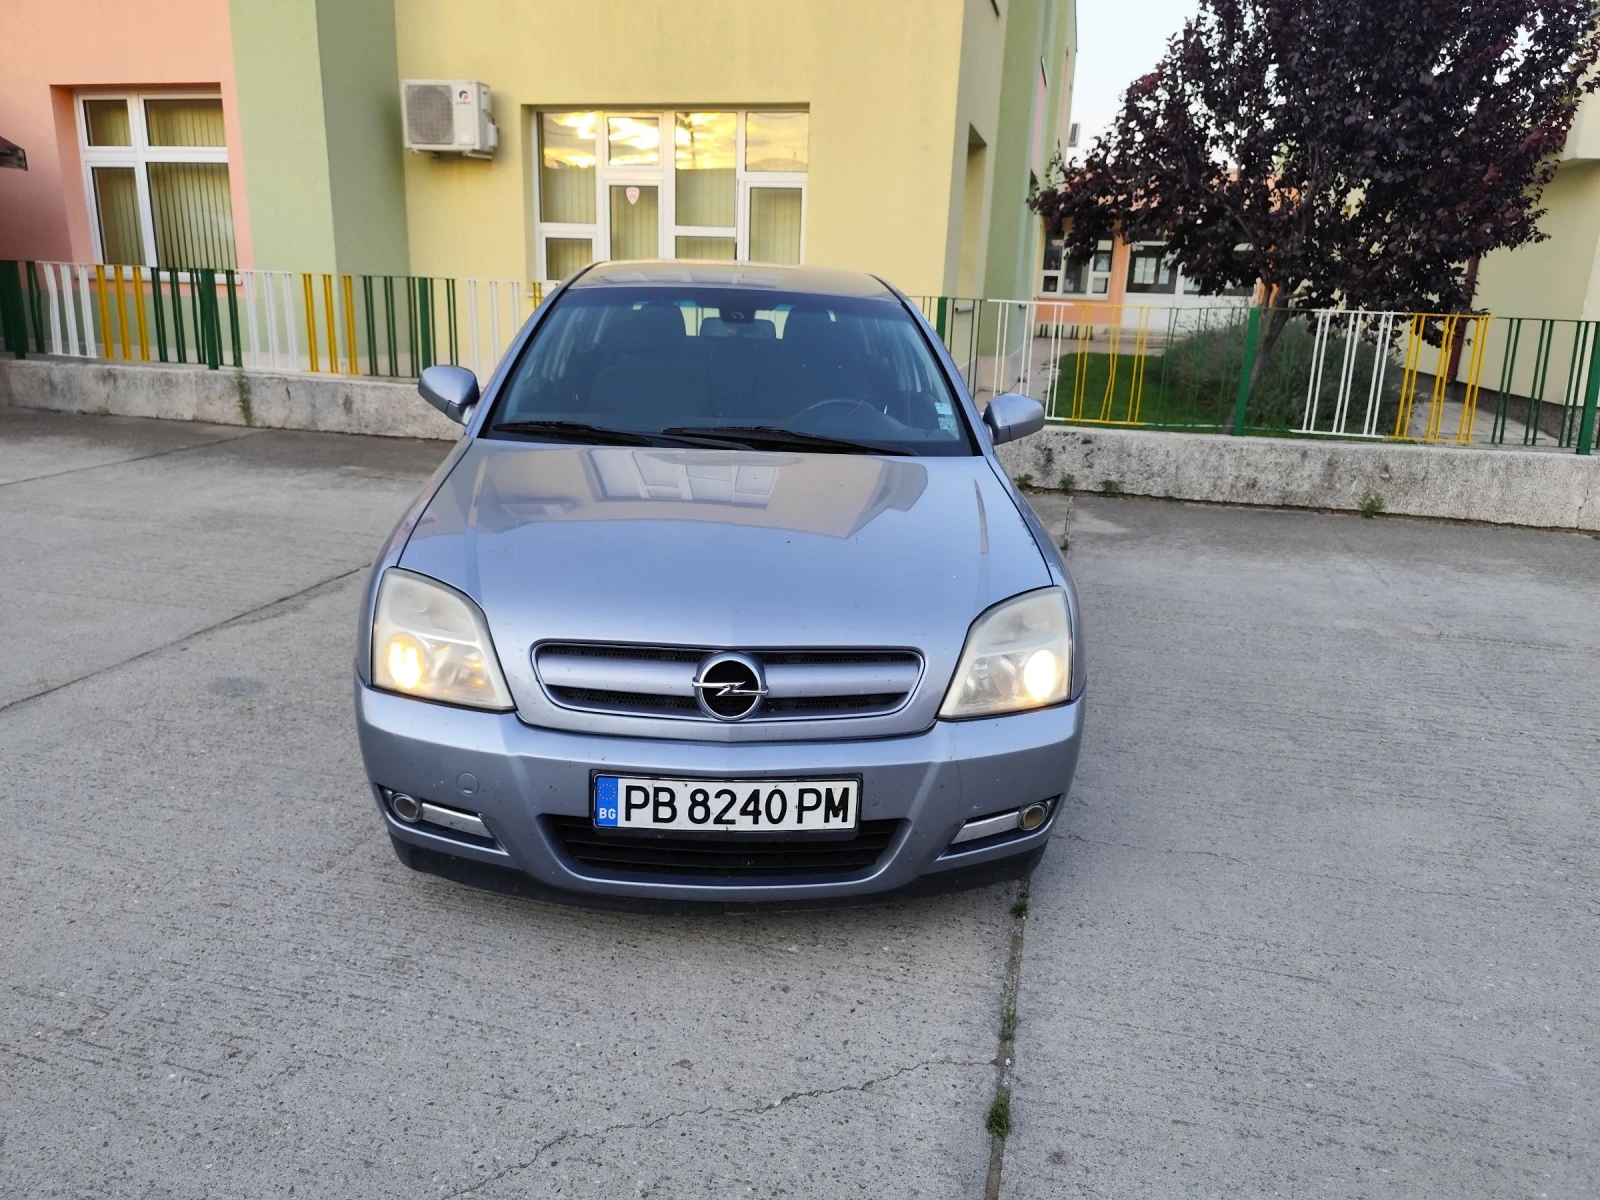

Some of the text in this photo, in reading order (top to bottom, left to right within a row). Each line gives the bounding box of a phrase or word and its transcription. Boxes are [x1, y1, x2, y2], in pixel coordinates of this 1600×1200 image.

[599, 807, 616, 819] BG
[625, 785, 850, 824] PB 8240 PM
